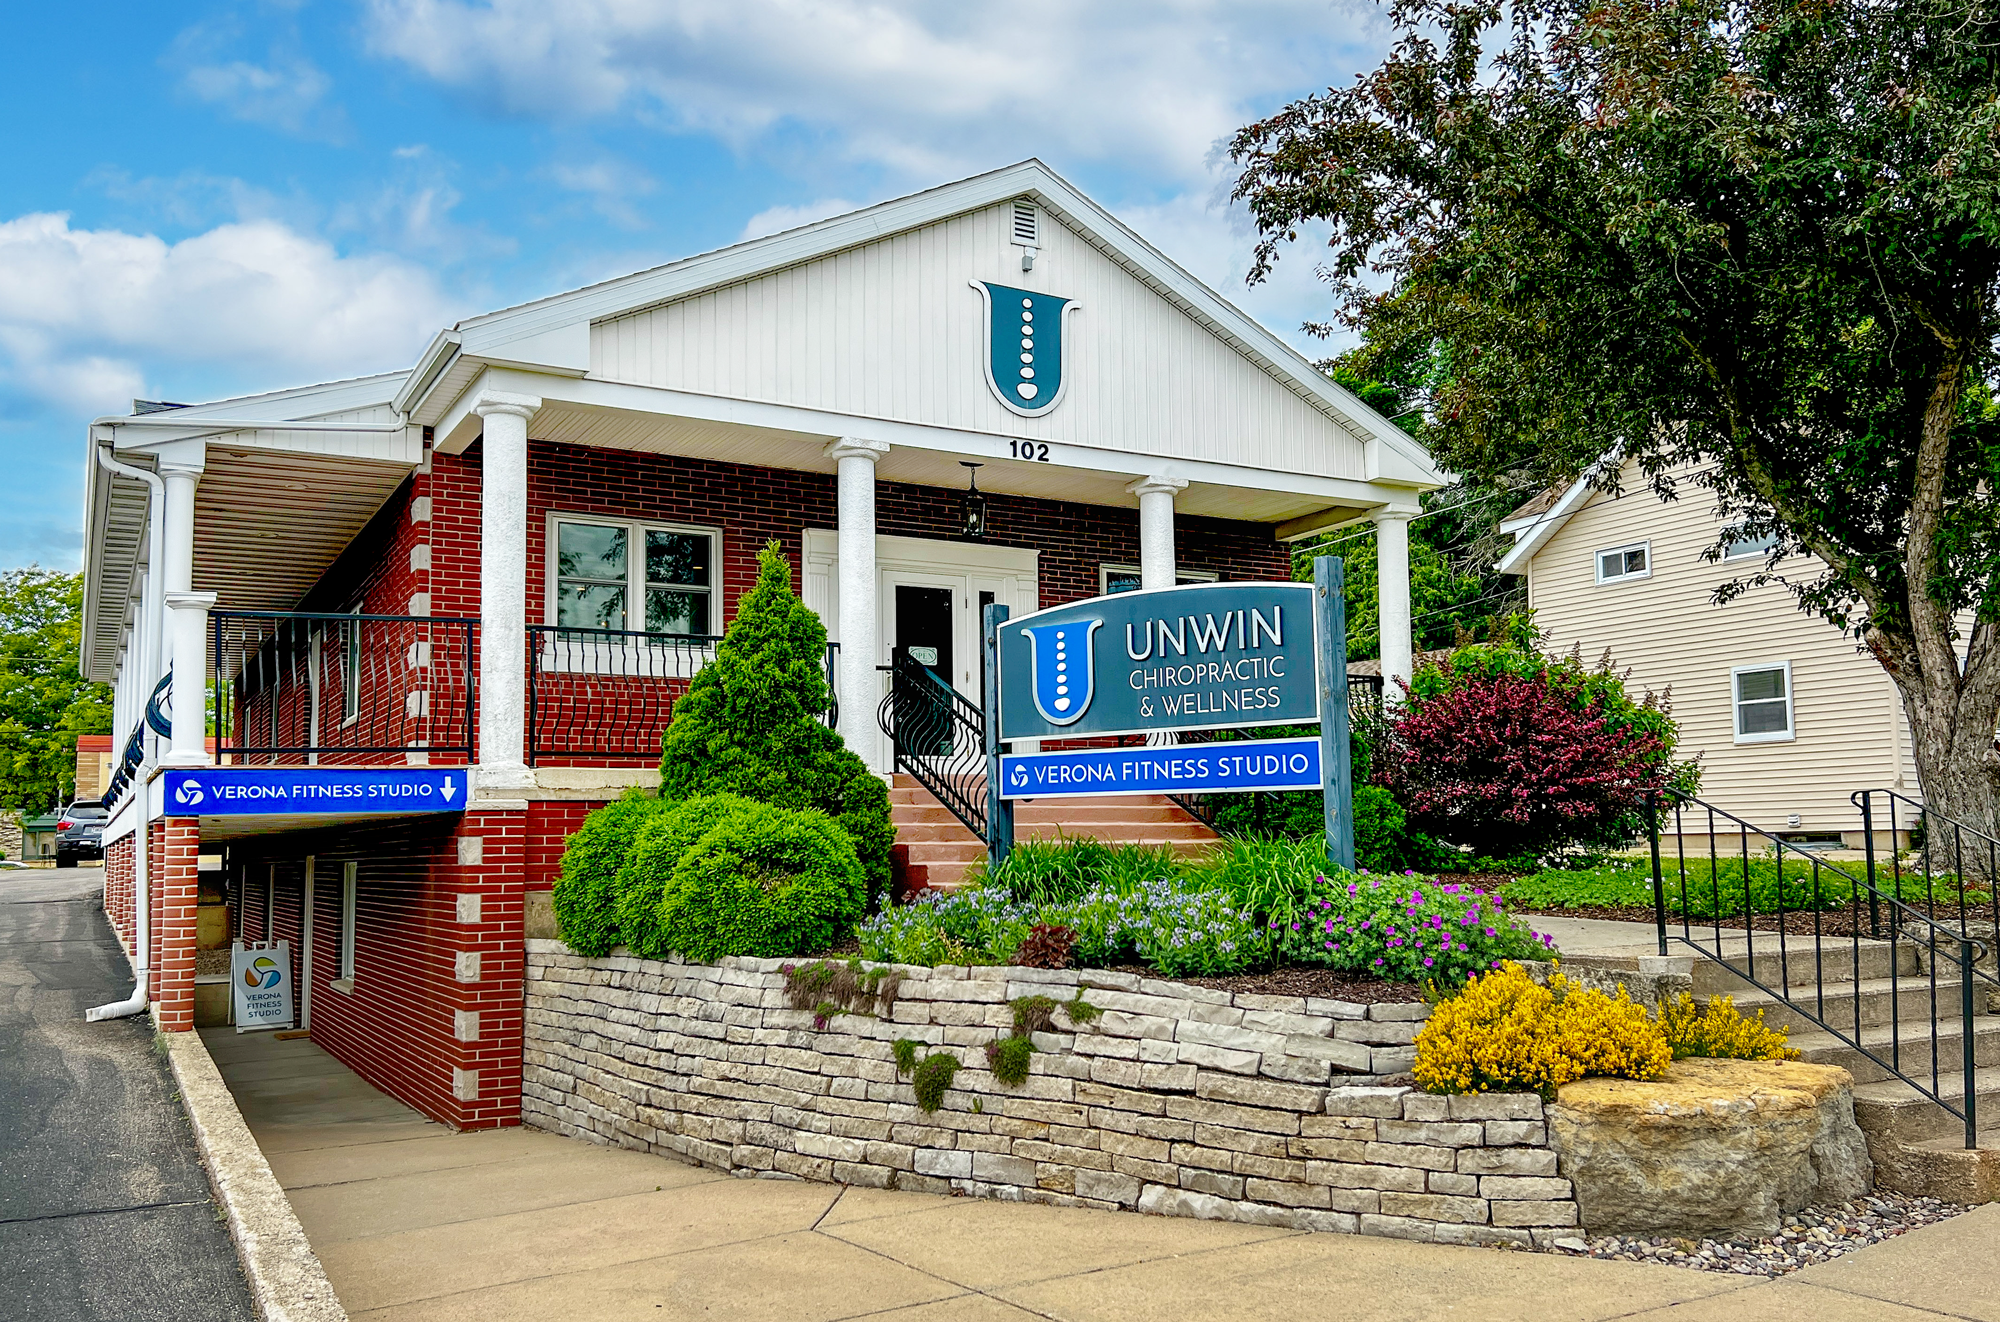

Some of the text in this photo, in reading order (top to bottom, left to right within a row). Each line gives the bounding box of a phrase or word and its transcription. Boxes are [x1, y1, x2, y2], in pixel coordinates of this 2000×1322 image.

[1009, 439, 1050, 463] 102
[1126, 605, 1283, 661] UNWIN
[1129, 655, 1285, 691] CHIROPRACTIC
[1140, 686, 1282, 718] & WELLNESS
[1033, 752, 1310, 785] VERONA FITNESS STUDIO
[211, 783, 433, 800] VERONA FITNESS STUDIO
[247, 1001, 282, 1009] FITNESS
[248, 1009, 282, 1018] STUDIO
